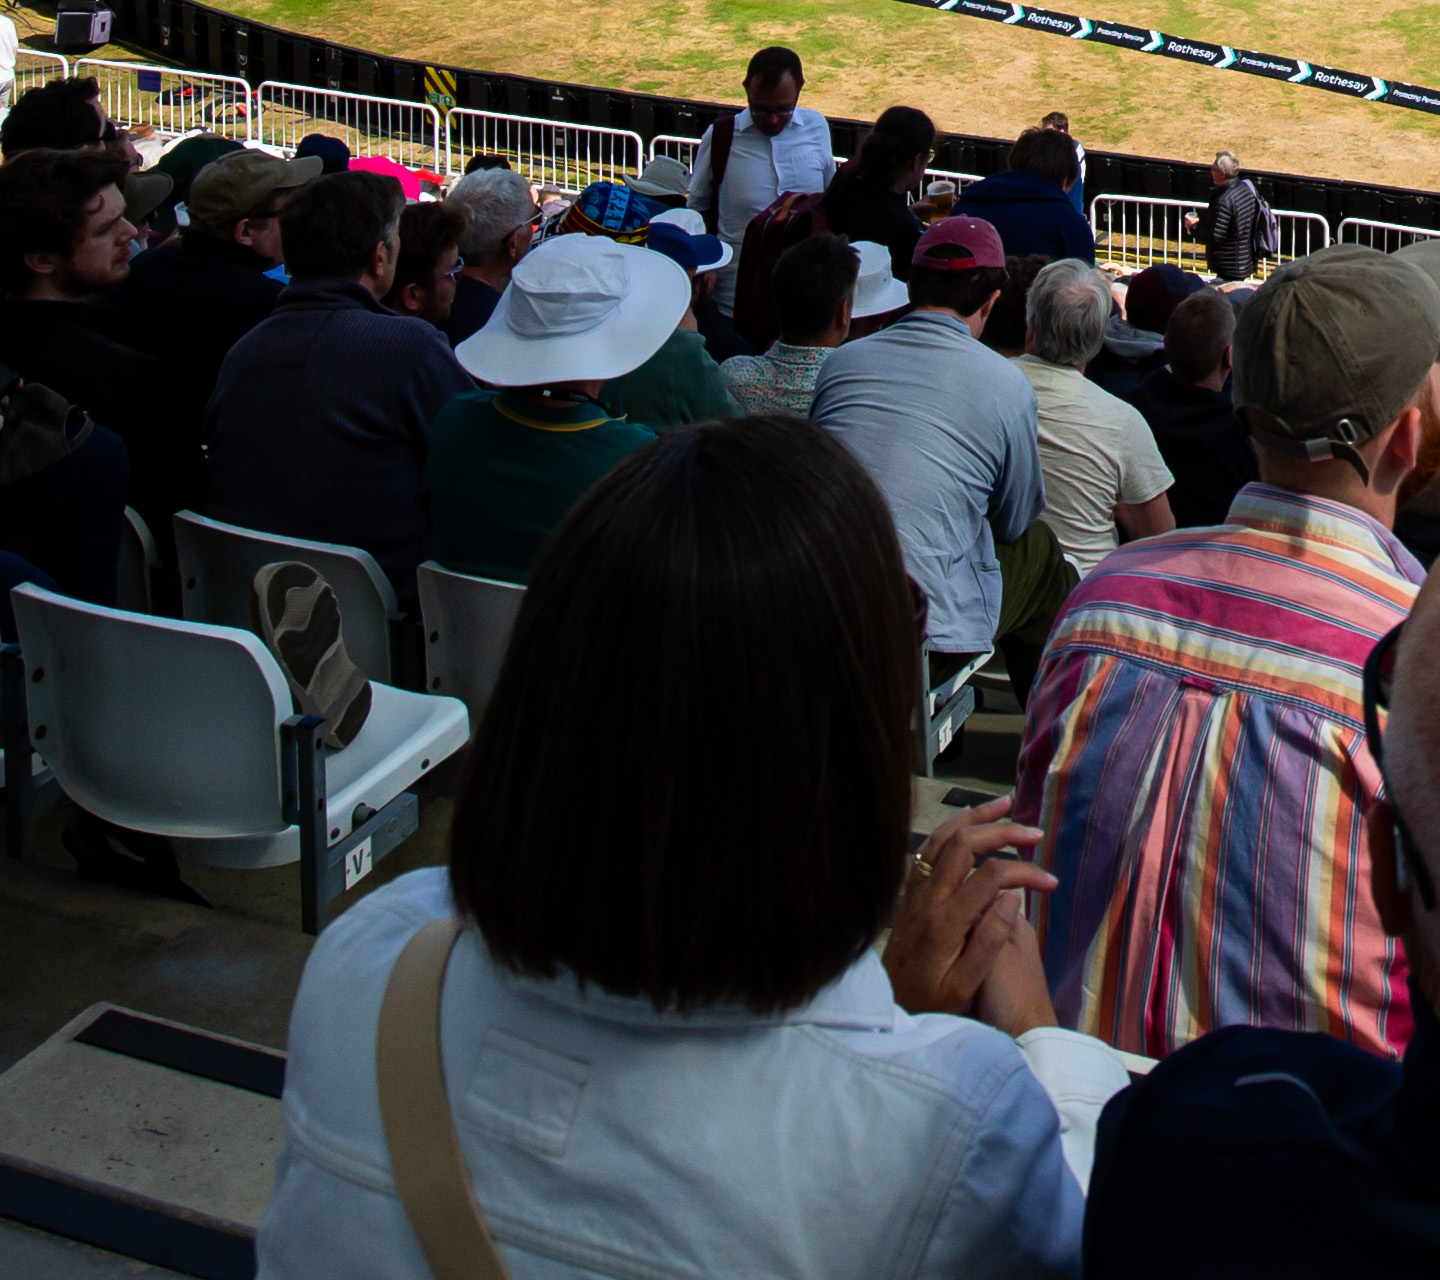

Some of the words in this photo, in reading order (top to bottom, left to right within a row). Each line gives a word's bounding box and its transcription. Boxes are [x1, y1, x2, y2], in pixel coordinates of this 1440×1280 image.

[1167, 41, 1218, 61] Rothesay
[1315, 71, 1367, 92] Rothesay
[353, 848, 364, 875] V
